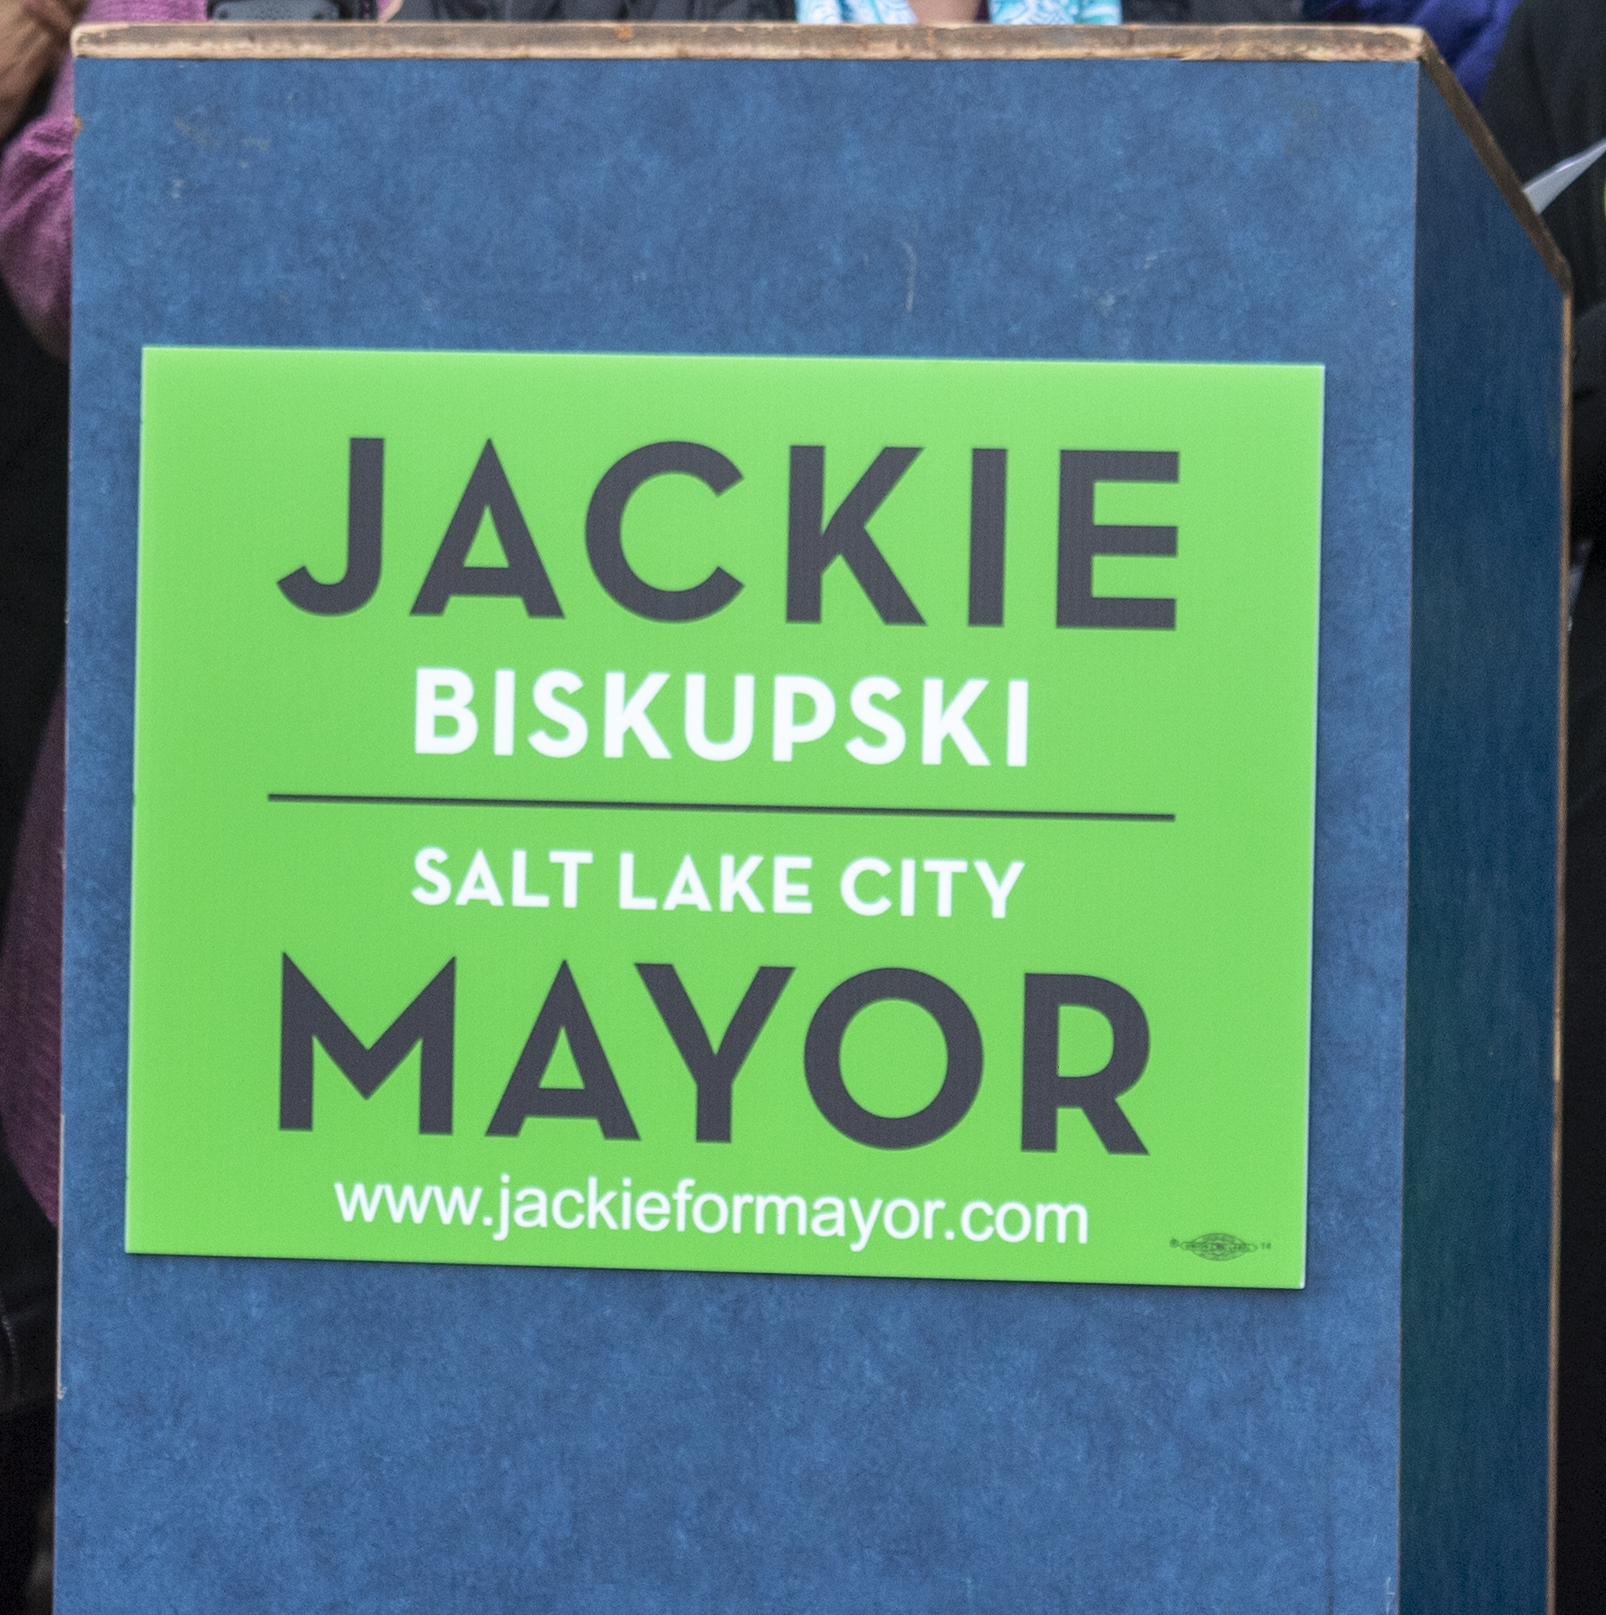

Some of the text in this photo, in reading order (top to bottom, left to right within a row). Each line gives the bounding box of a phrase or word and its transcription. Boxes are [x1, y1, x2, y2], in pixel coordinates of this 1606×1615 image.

[276, 437, 1181, 631] JACKIE
[413, 666, 1029, 767] BISKUPSKI
[411, 846, 1027, 919] SALT LAKE CITY
[278, 951, 1152, 1156] MAYOR
[333, 1172, 1089, 1252] www.jackieformayor.com
